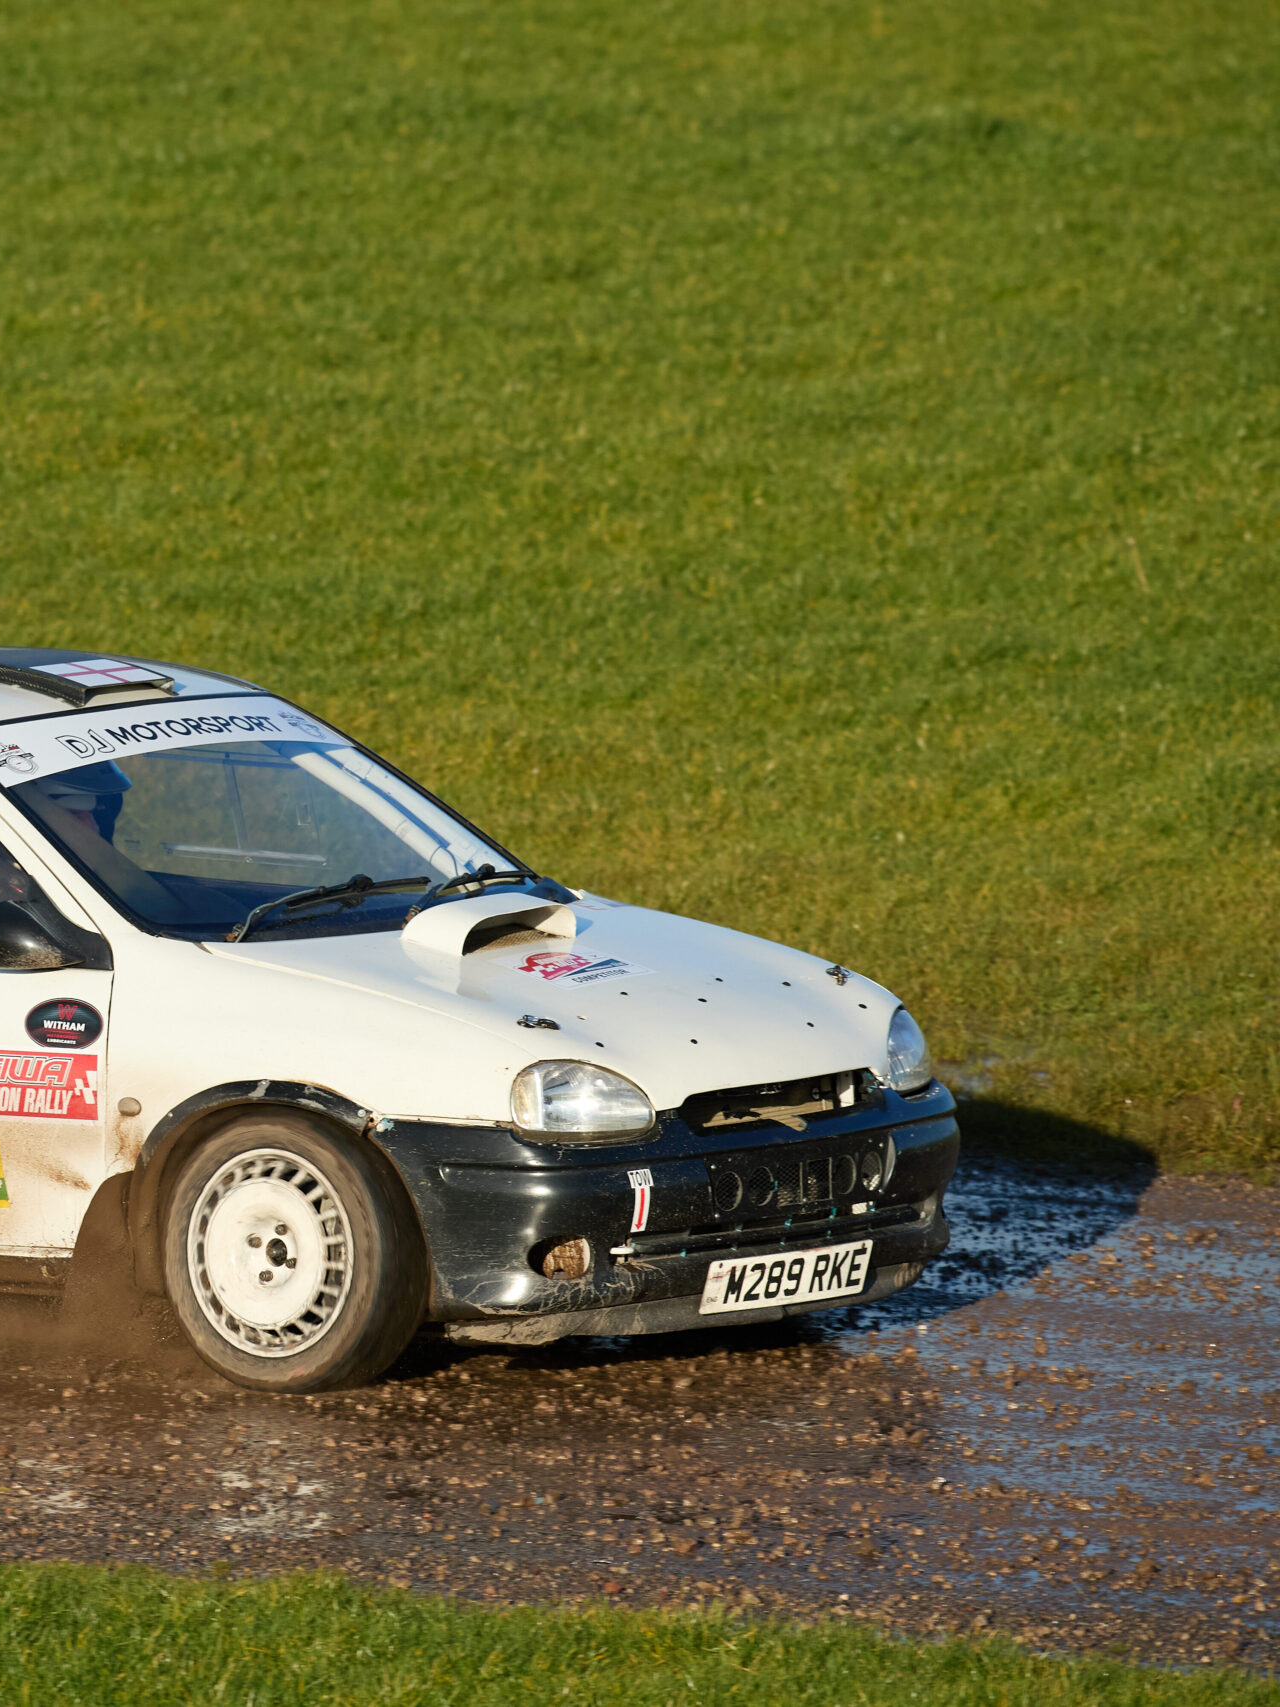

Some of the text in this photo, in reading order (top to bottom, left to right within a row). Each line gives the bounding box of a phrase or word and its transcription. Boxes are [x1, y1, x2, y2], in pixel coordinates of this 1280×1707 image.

[55, 729, 116, 759] DJ
[105, 715, 282, 746] MOTORSPORT
[571, 968, 630, 983] COMPETITOR
[43, 1019, 86, 1032] WITHAM
[23, 1088, 74, 1115] RALLY
[628, 1170, 652, 1187] TOW
[723, 1247, 868, 1304] M289 RKE
